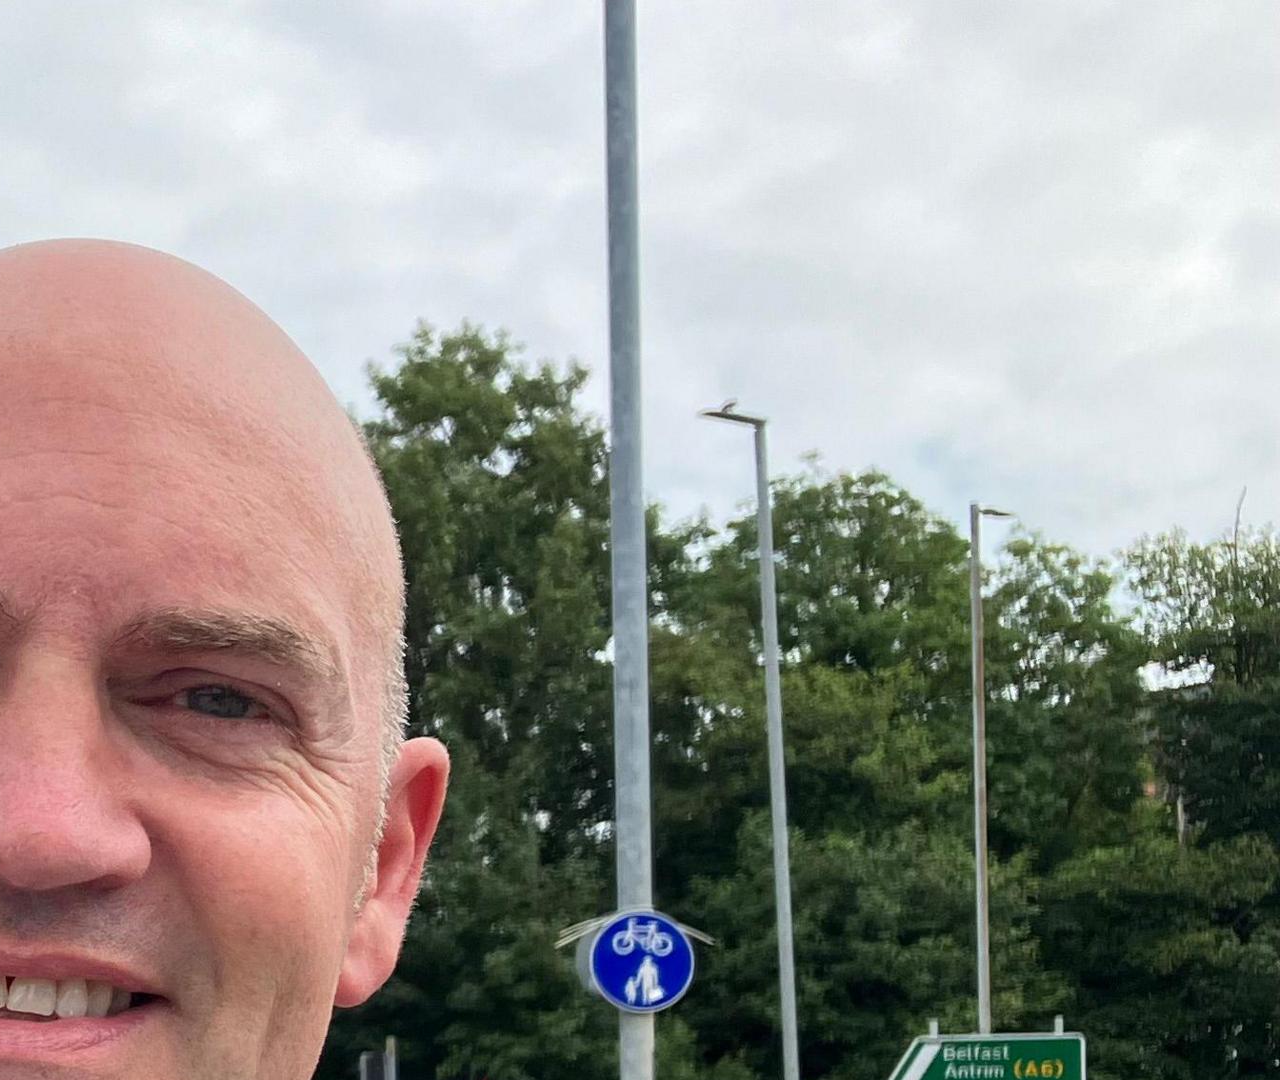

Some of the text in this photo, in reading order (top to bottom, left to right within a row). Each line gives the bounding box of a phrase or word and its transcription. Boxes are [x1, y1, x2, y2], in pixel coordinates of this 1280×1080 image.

[943, 1044, 1010, 1061] Belfast
[944, 1059, 1064, 1079] Antrim (A6)
